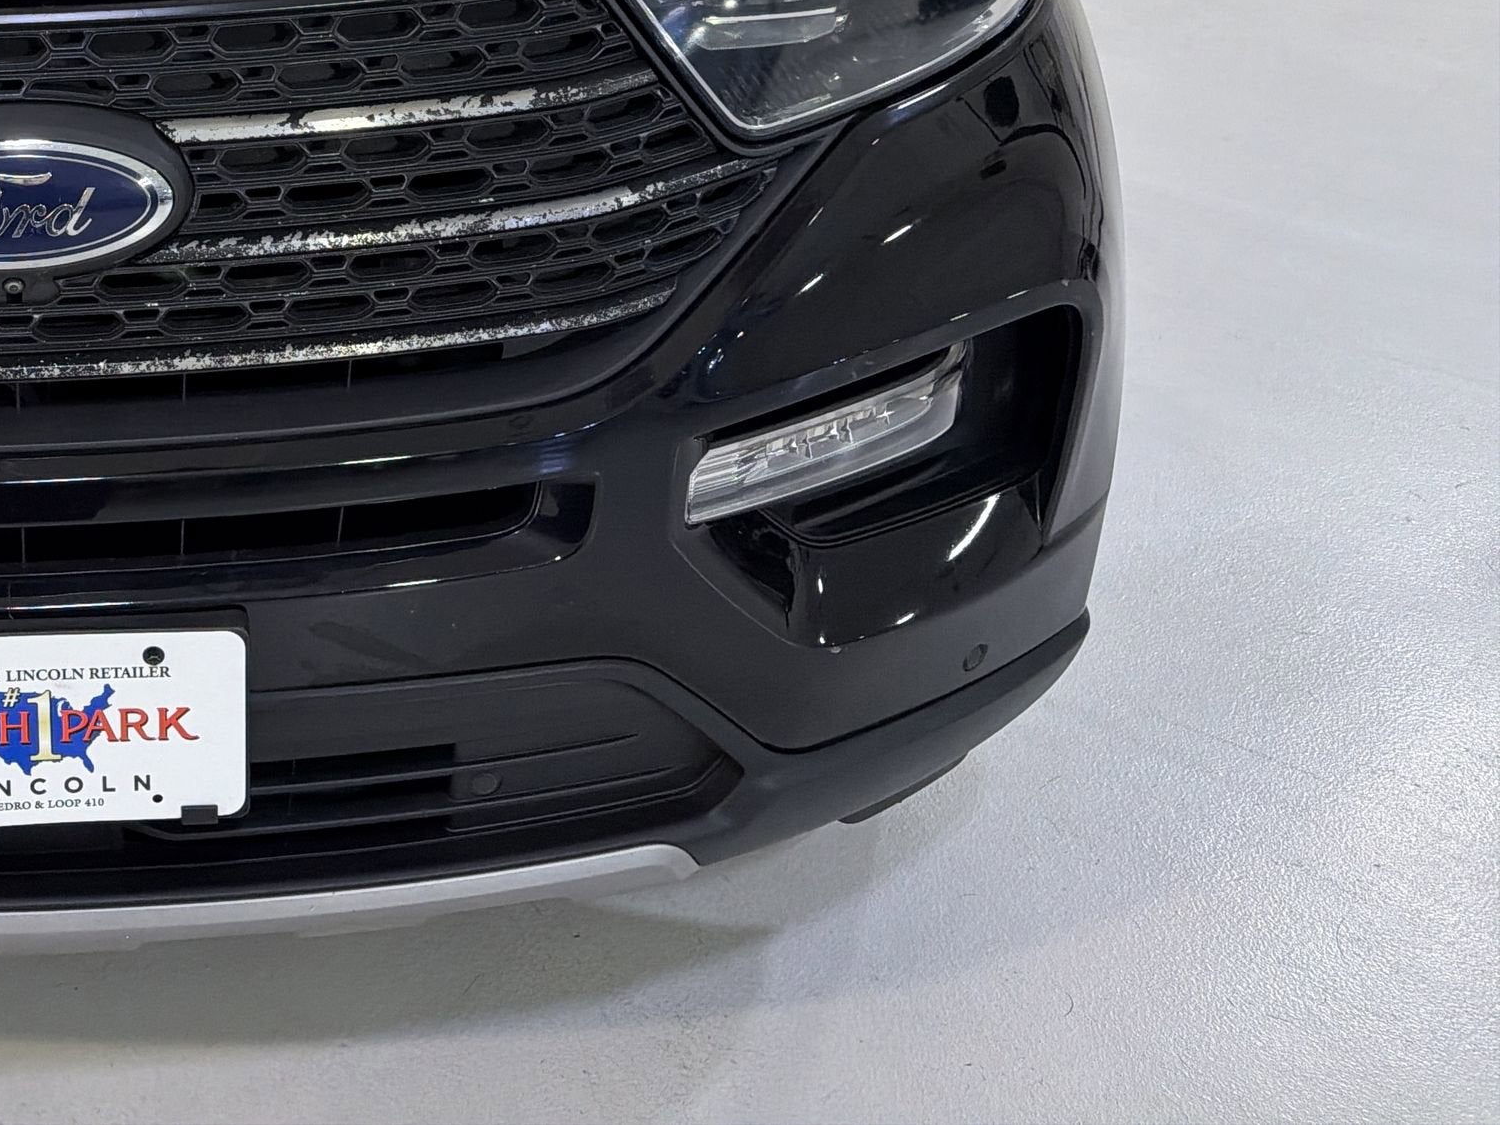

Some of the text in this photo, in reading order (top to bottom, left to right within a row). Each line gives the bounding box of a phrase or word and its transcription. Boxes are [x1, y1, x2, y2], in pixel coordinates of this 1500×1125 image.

[6, 667, 84, 682] LINCOLN
[88, 666, 172, 680] RETAILER
[60, 706, 200, 744] PARK
[34, 799, 45, 810] &
[48, 798, 82, 810] LOOP
[84, 797, 105, 808] 410
